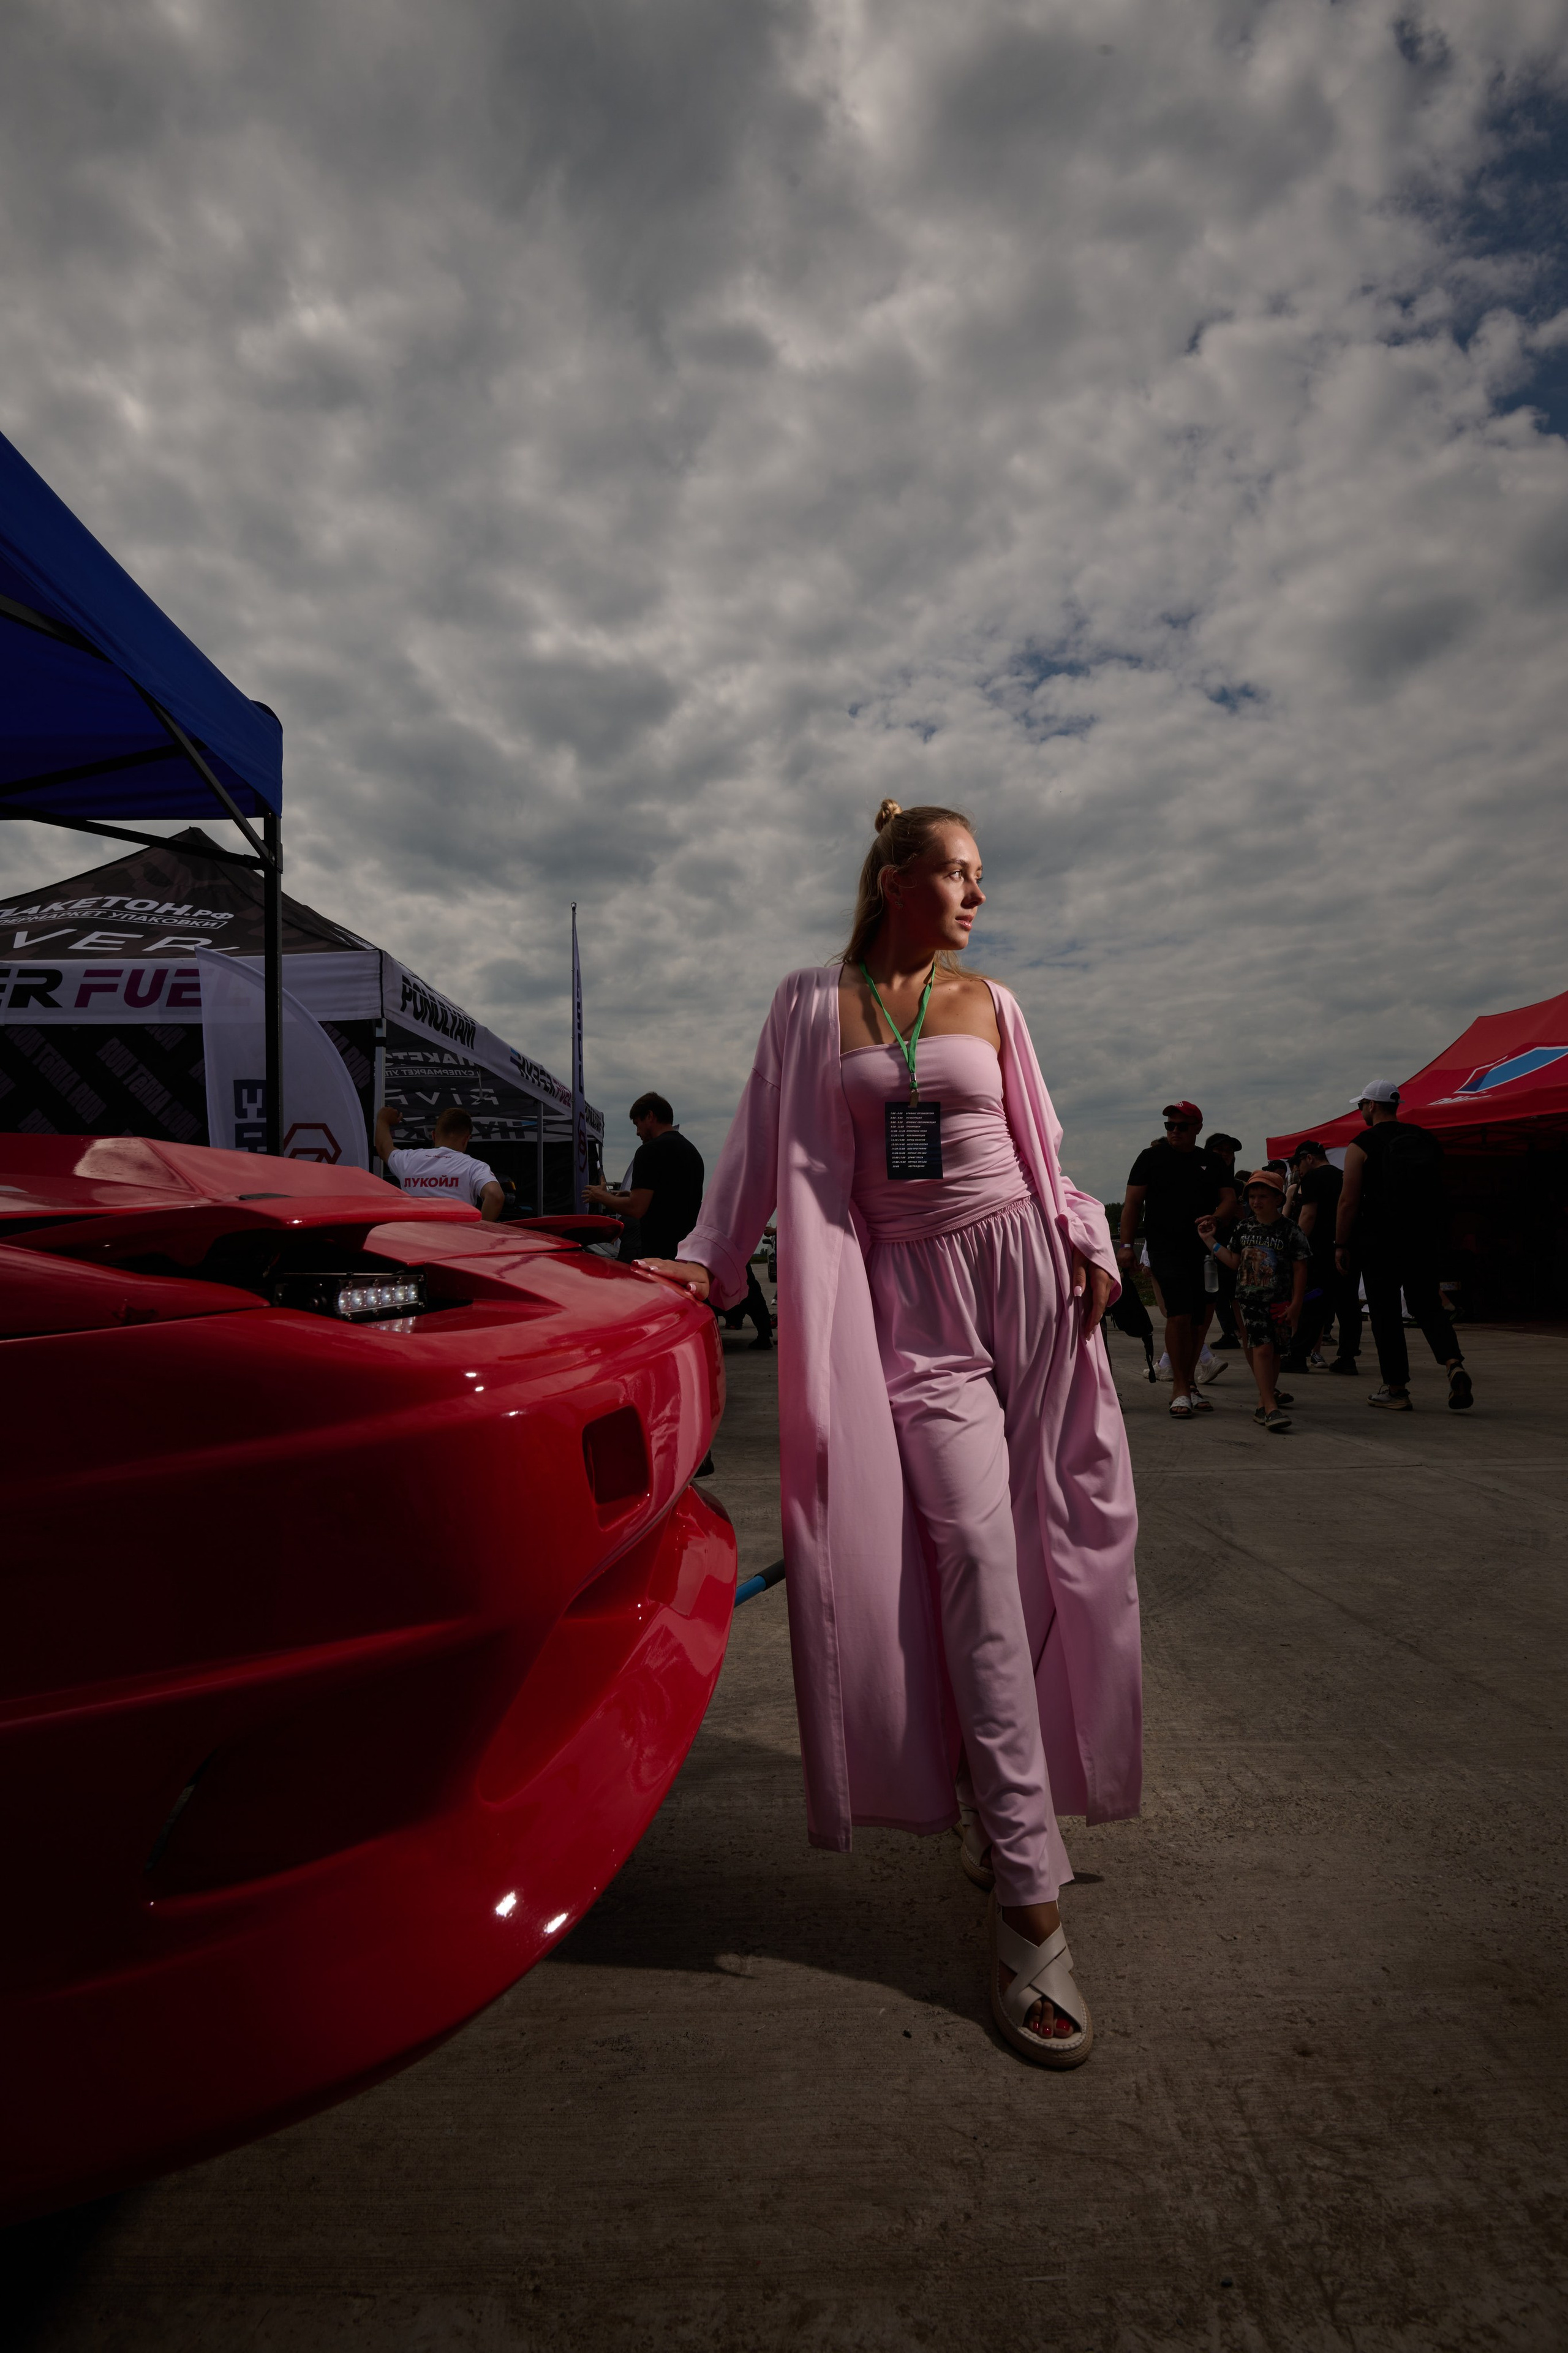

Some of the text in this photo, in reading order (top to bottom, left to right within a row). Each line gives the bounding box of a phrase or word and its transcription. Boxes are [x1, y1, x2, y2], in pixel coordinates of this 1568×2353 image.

[111, 912, 222, 927] УПАКОВКИ
[404, 1175, 459, 1187] ЛУКОЙЛ
[1240, 1235, 1284, 1250] THAILAND
